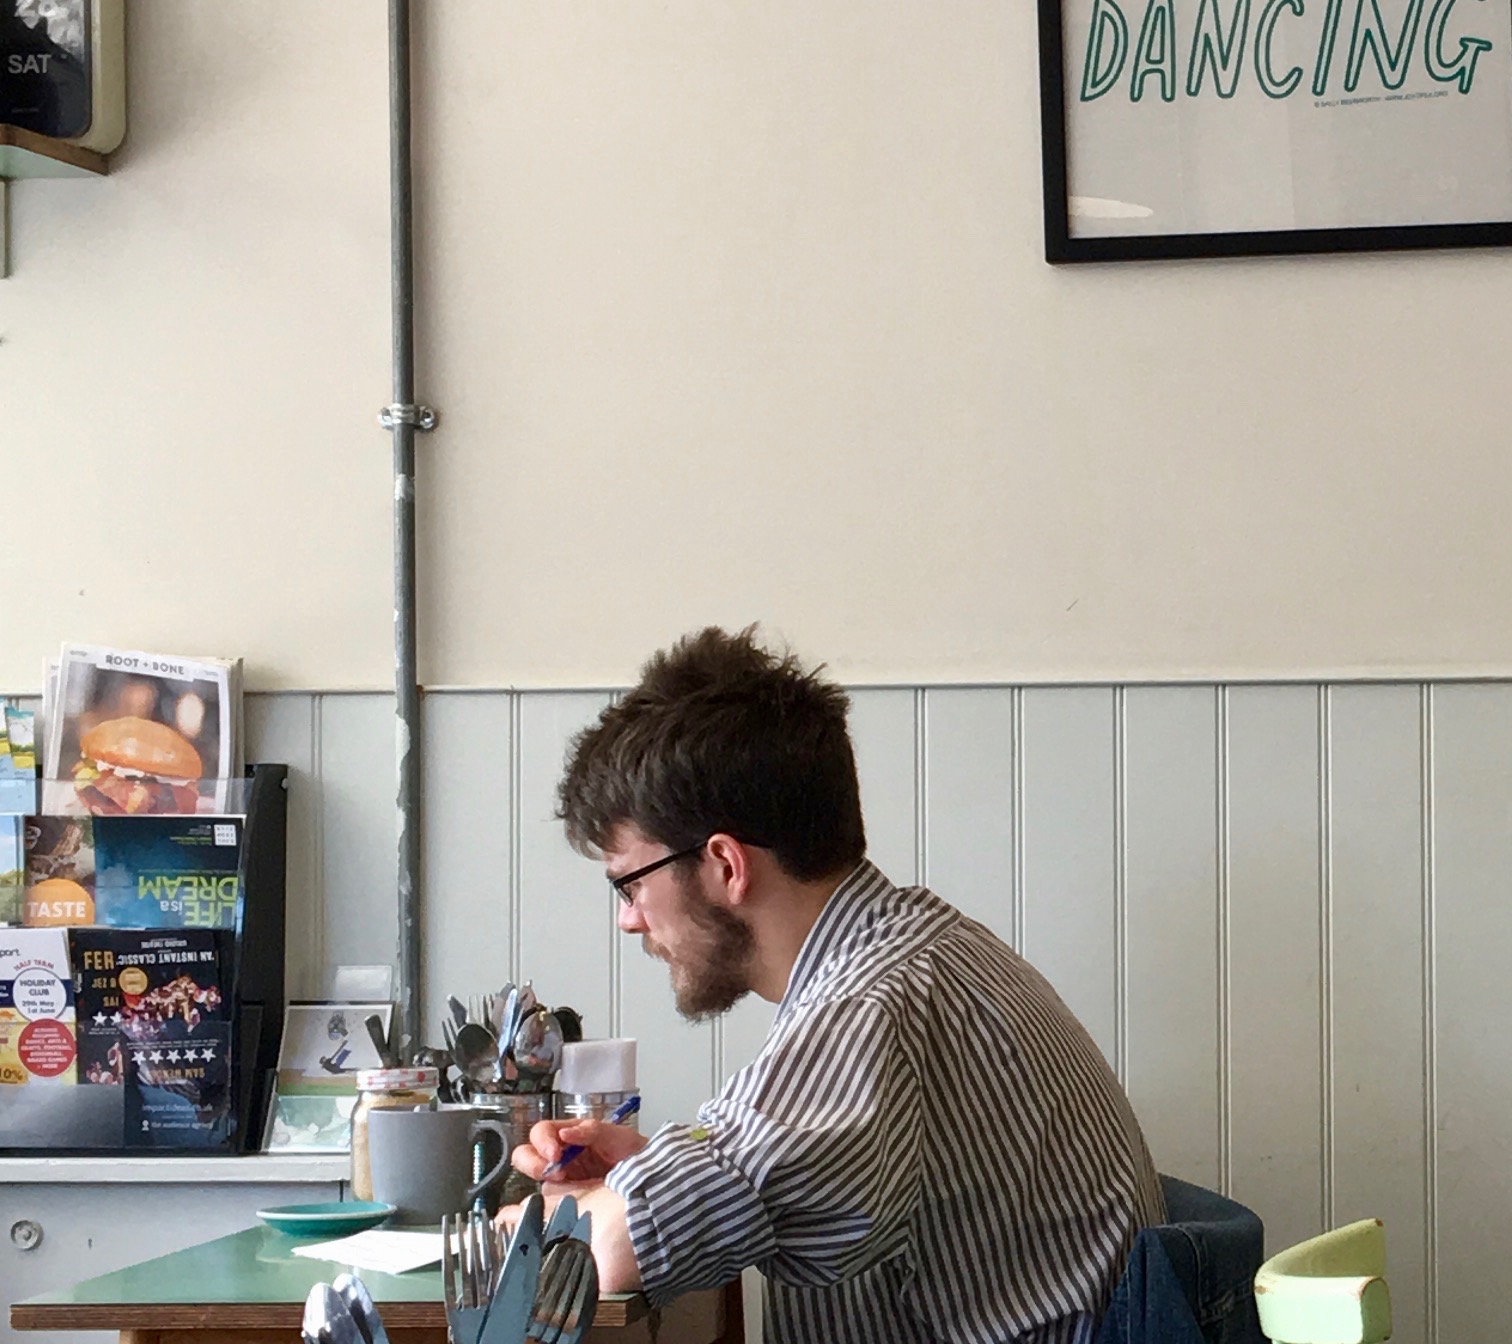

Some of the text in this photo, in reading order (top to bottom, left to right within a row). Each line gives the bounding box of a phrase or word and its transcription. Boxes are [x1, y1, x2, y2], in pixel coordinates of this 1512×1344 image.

[7, 54, 52, 74] SAT
[105, 654, 139, 668] ROOT
[152, 662, 185, 675] BONE
[138, 876, 239, 900] DREAM
[27, 901, 86, 918] TASTE
[184, 900, 236, 926] LIFE
[20, 979, 56, 987] HOLIDAY
[28, 988, 50, 996] CLUB
